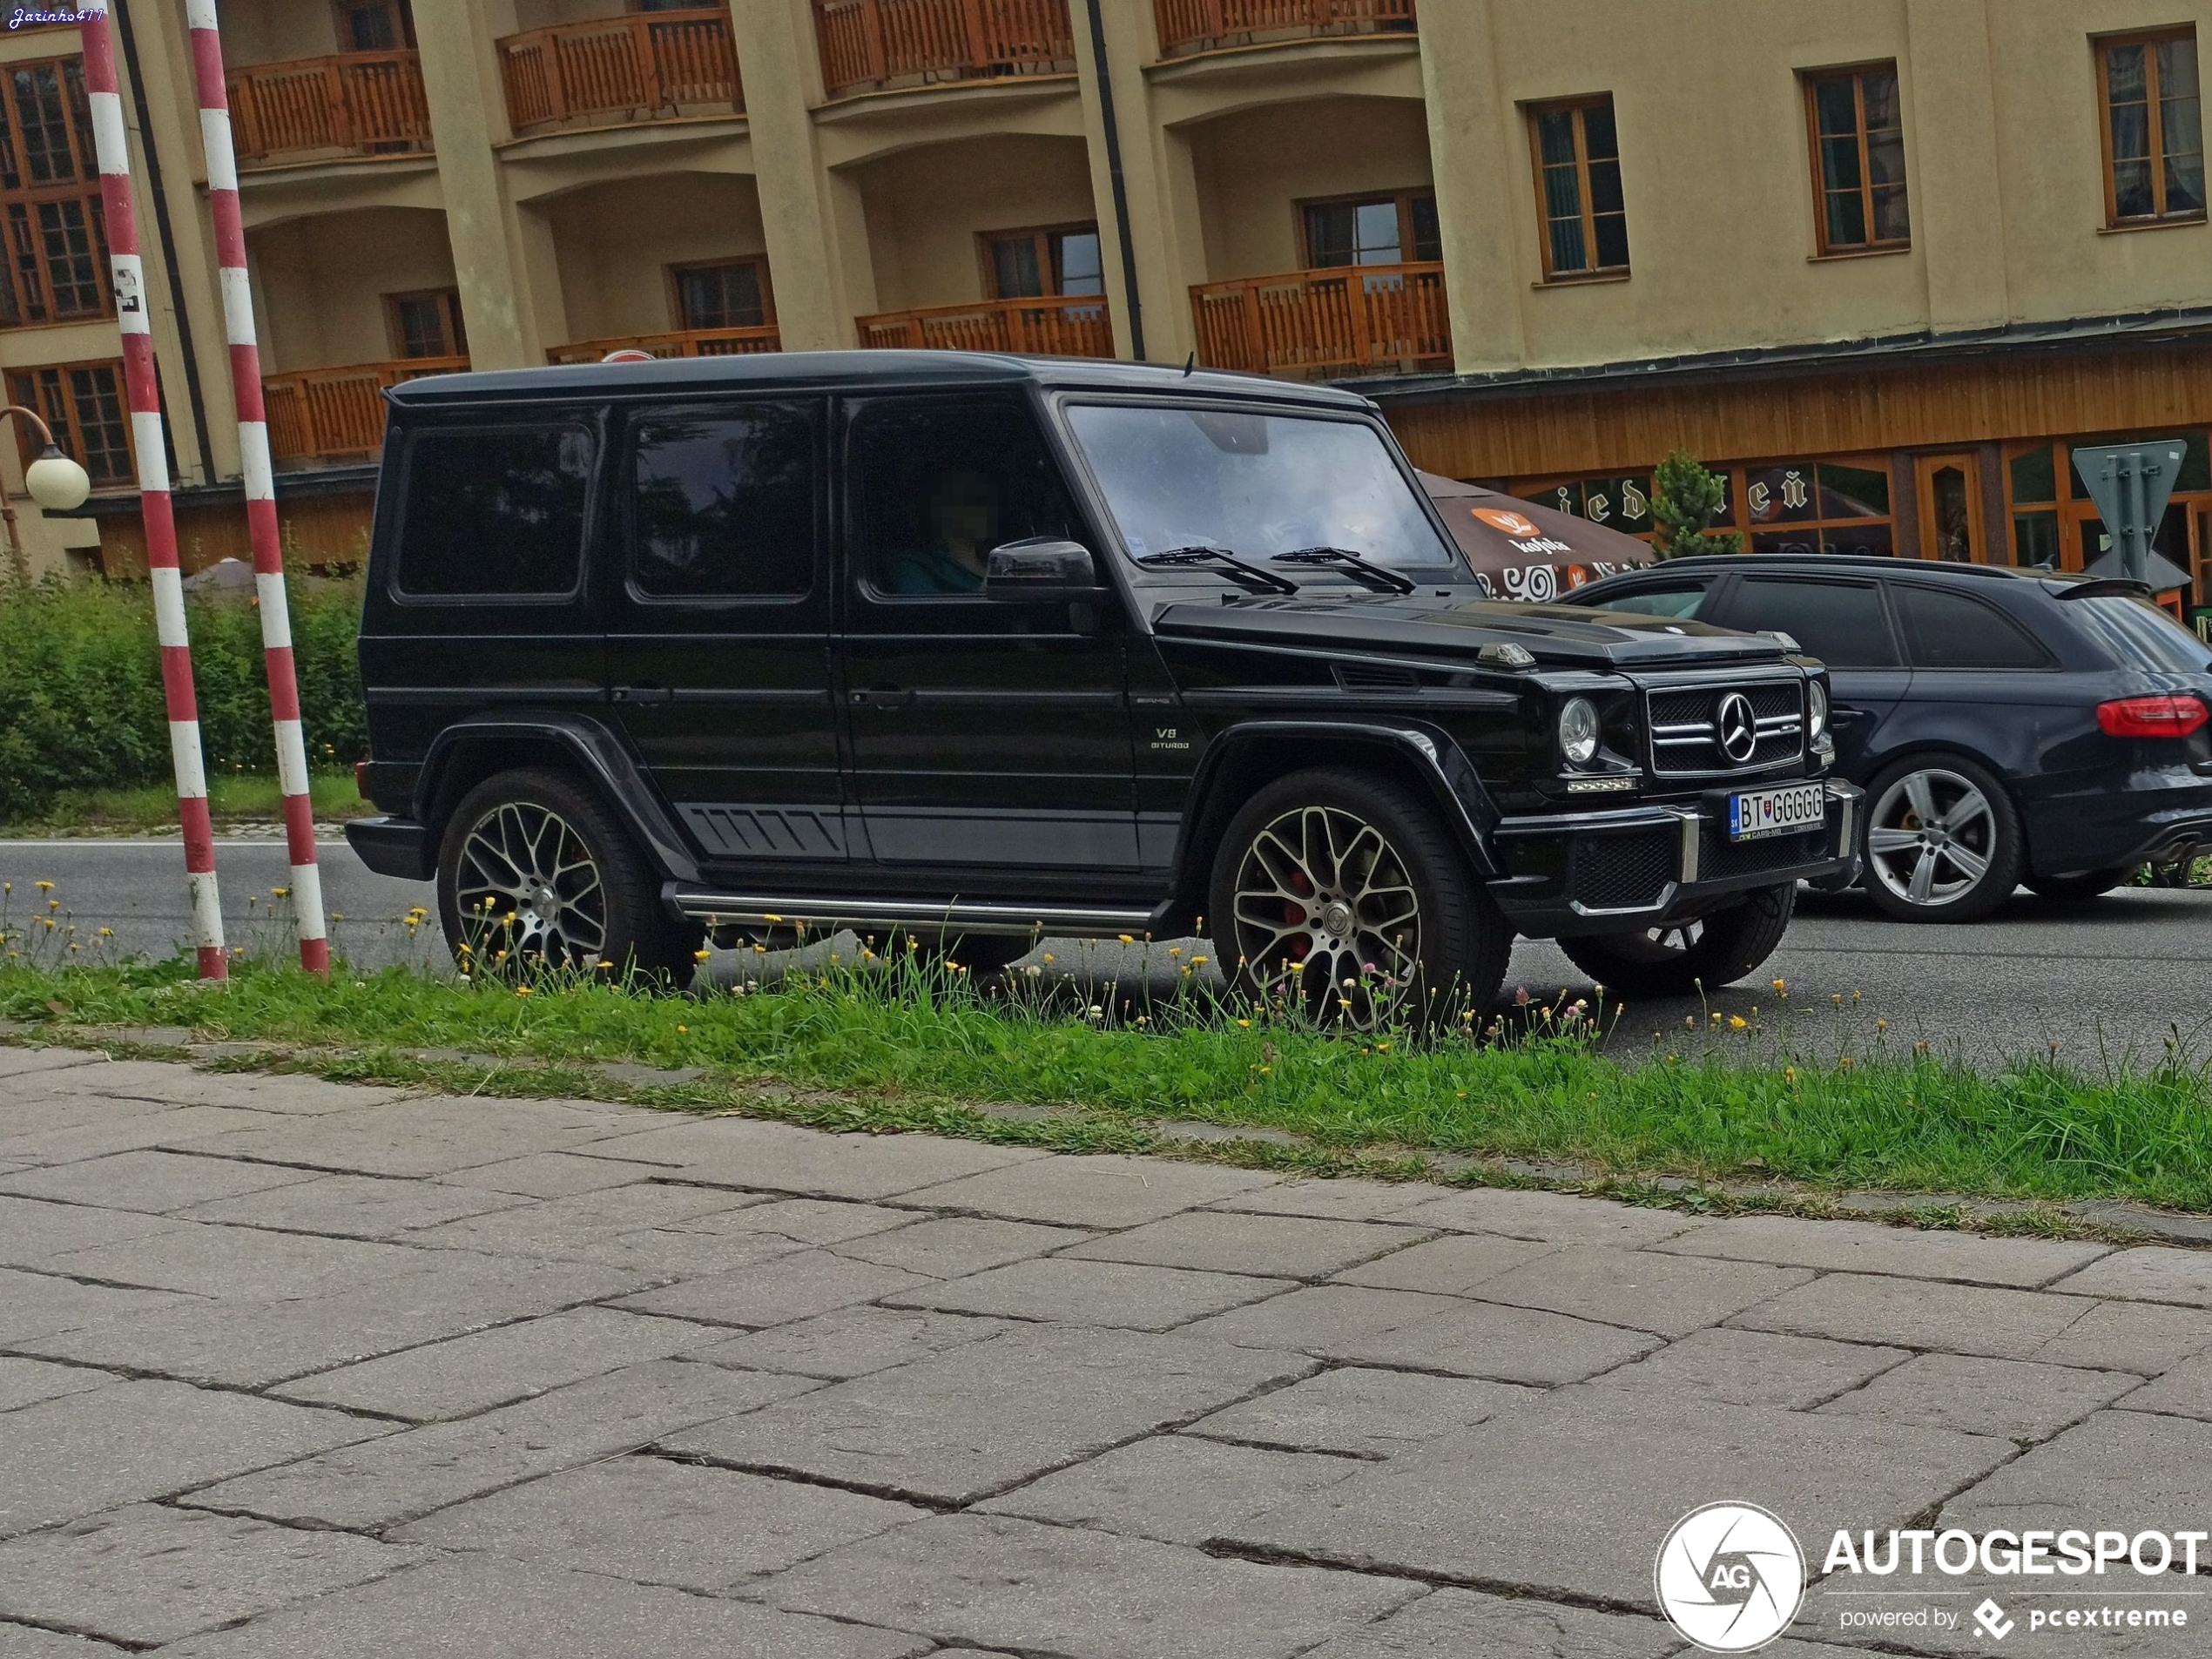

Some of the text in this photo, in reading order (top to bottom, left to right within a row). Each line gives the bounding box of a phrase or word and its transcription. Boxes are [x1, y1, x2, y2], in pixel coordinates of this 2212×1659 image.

[1507, 536, 1572, 556] kofola
[1156, 728, 1177, 738] V8
[1742, 788, 1822, 827] BT GGGGG
[1730, 819, 1738, 827] SK
